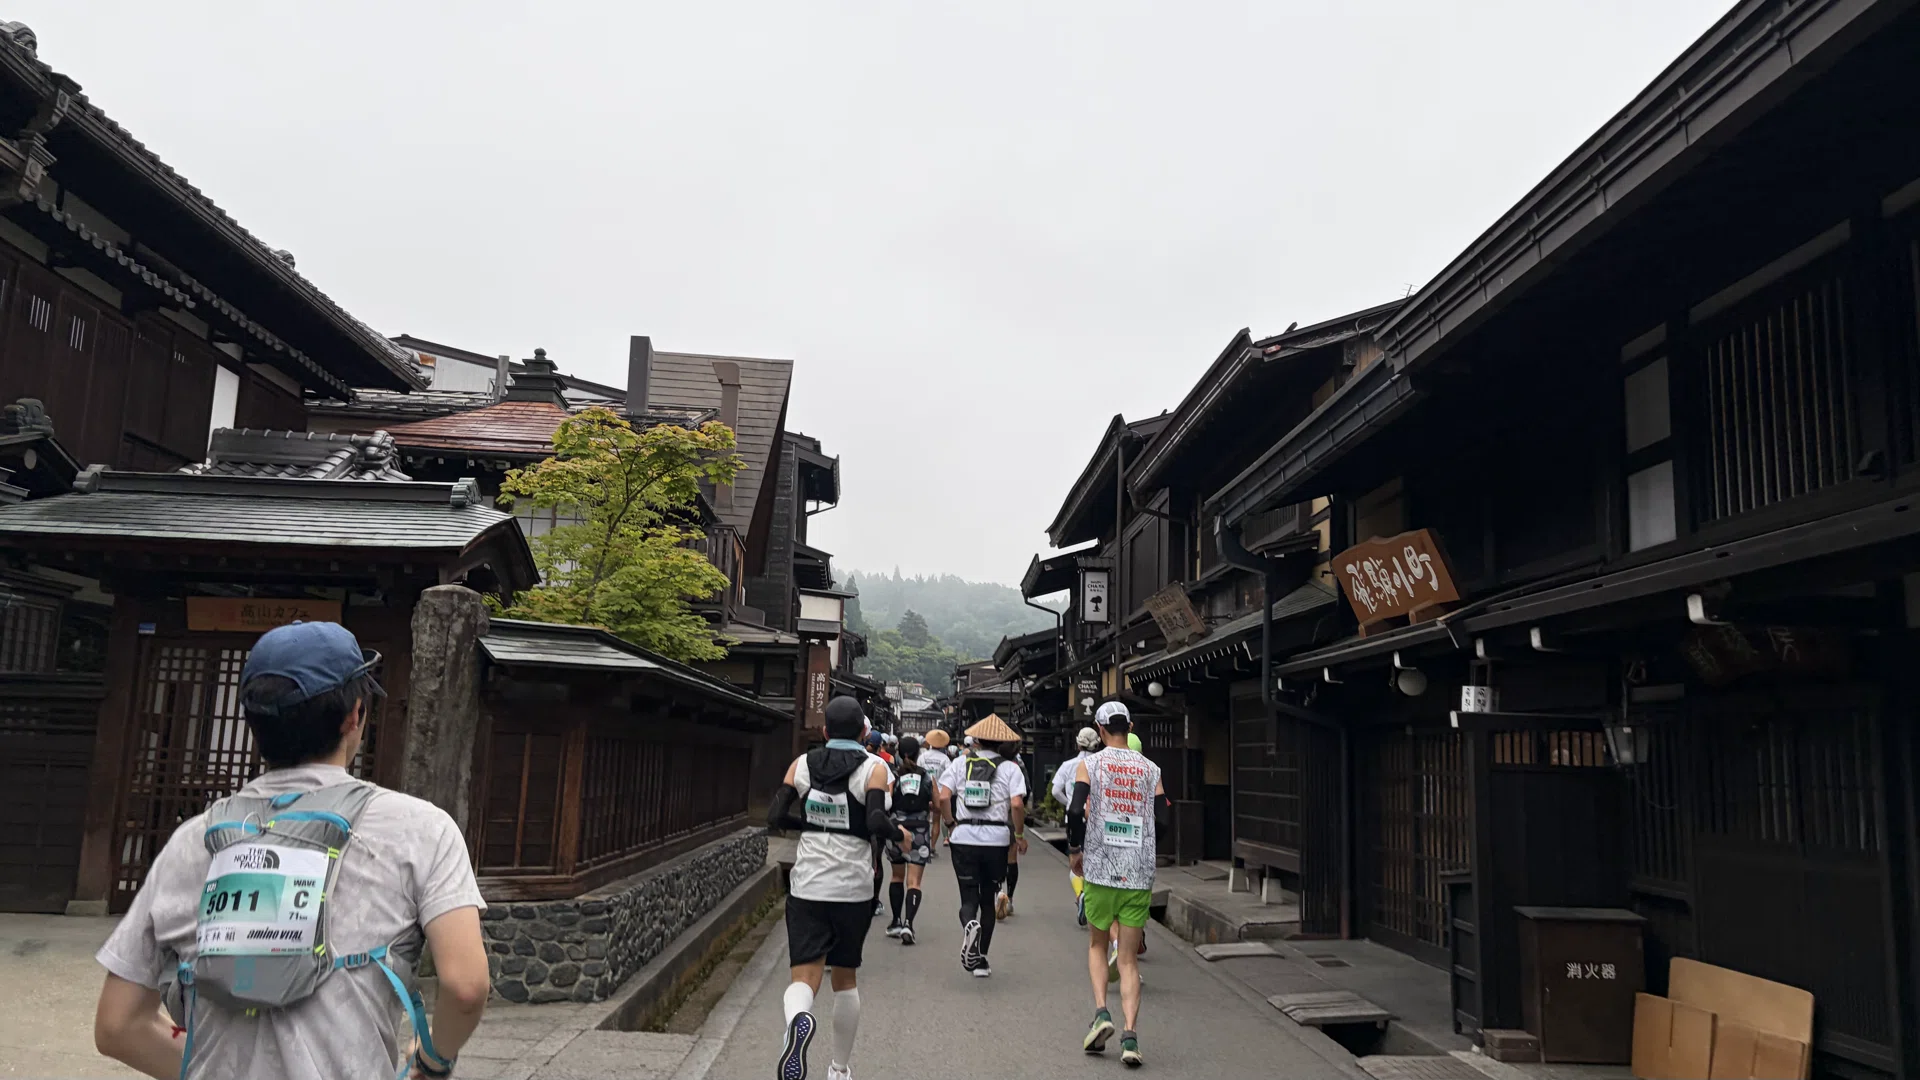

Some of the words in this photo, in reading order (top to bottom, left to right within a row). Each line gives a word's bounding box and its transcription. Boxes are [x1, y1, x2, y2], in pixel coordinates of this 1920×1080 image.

[241, 604, 310, 618] 高山カフェ
[816, 672, 826, 714] 高山カフェ
[1107, 763, 1143, 776] WATCH
[1105, 788, 1143, 802] BEHIND
[1109, 825, 1127, 834] 6070
[293, 879, 316, 888] WAVE
[206, 889, 260, 915] 5011
[293, 890, 310, 909] C
[279, 929, 304, 942] VITAL
[1566, 962, 1616, 980] 消火器
